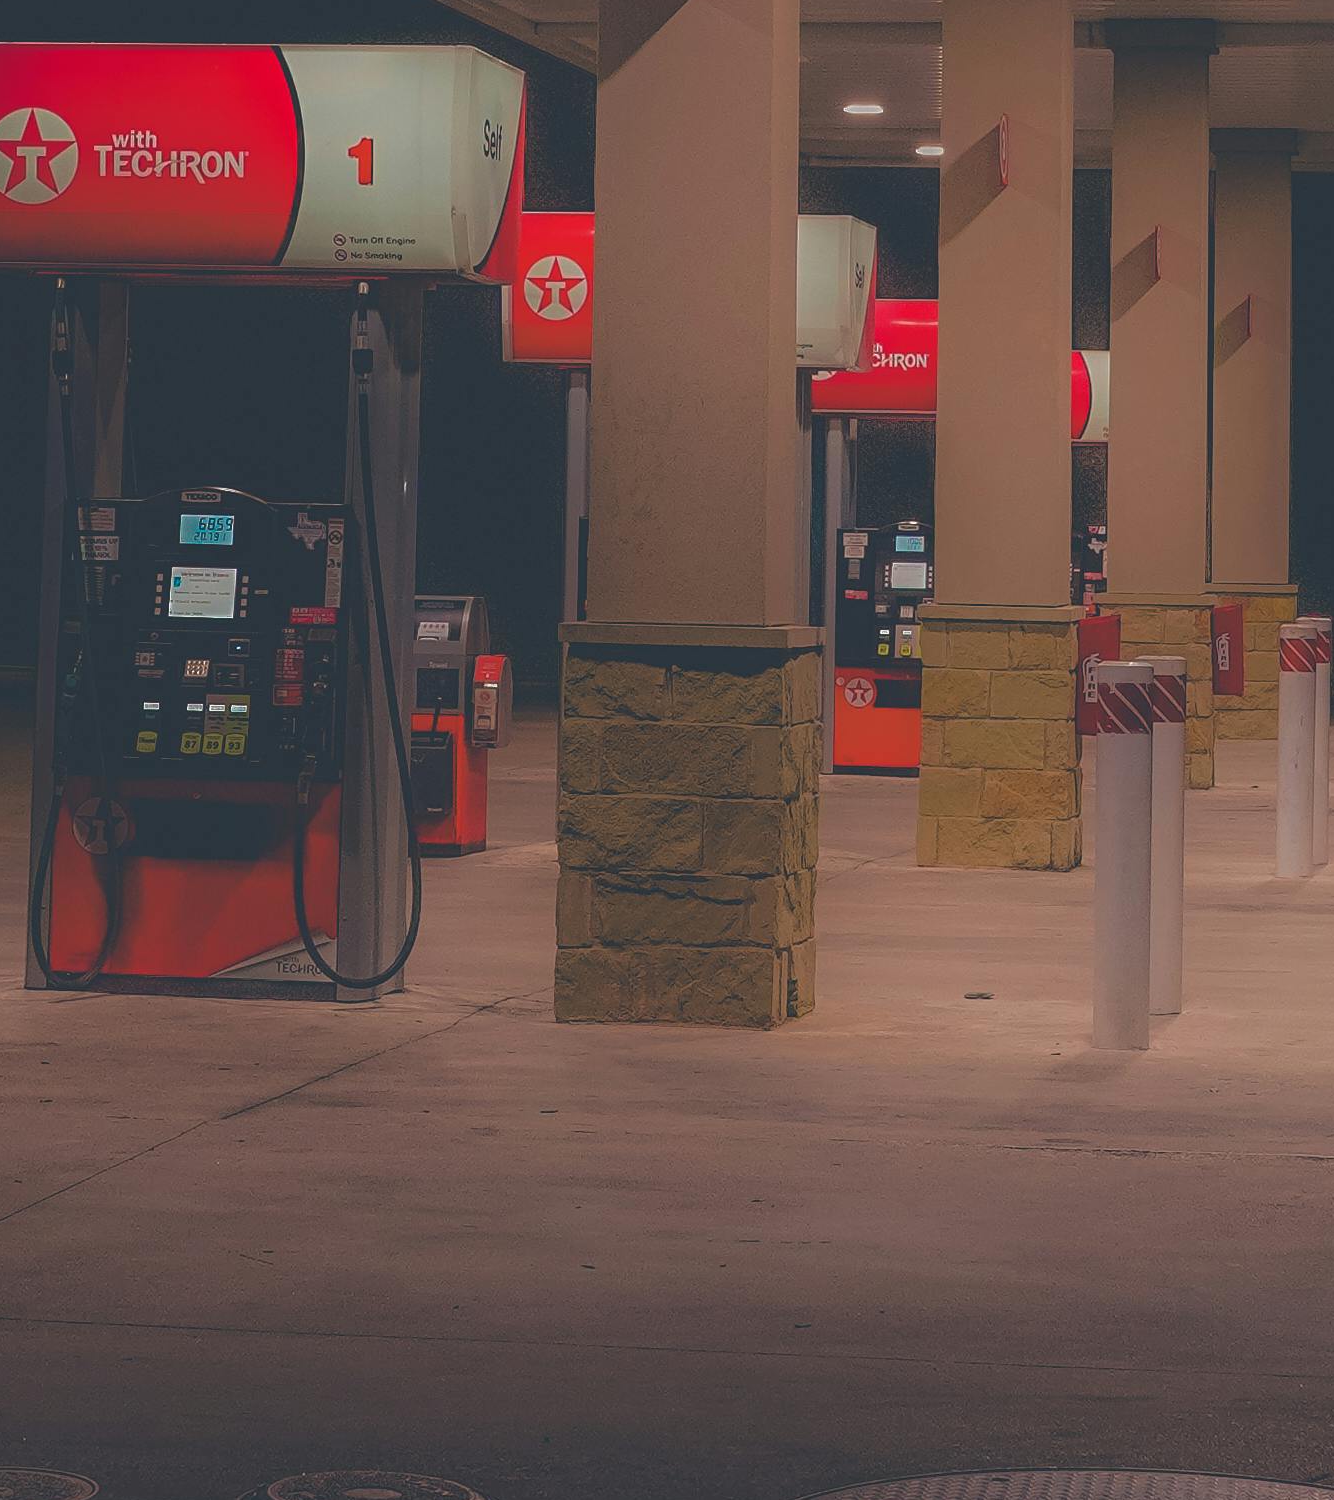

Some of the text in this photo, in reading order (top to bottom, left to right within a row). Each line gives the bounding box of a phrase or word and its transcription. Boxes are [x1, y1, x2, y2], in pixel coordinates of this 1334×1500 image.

[112, 130, 157, 149] with
[483, 119, 503, 161] Self
[93, 145, 246, 184] TECHRON
[348, 137, 374, 185] 1
[349, 236, 416, 246] Turn Off Engine
[364, 252, 403, 261] Smoking
[872, 354, 928, 371] CHRON
[1088, 666, 1097, 698] FIRE
[184, 740, 197, 749] 87
[276, 961, 324, 976] TECHRO
